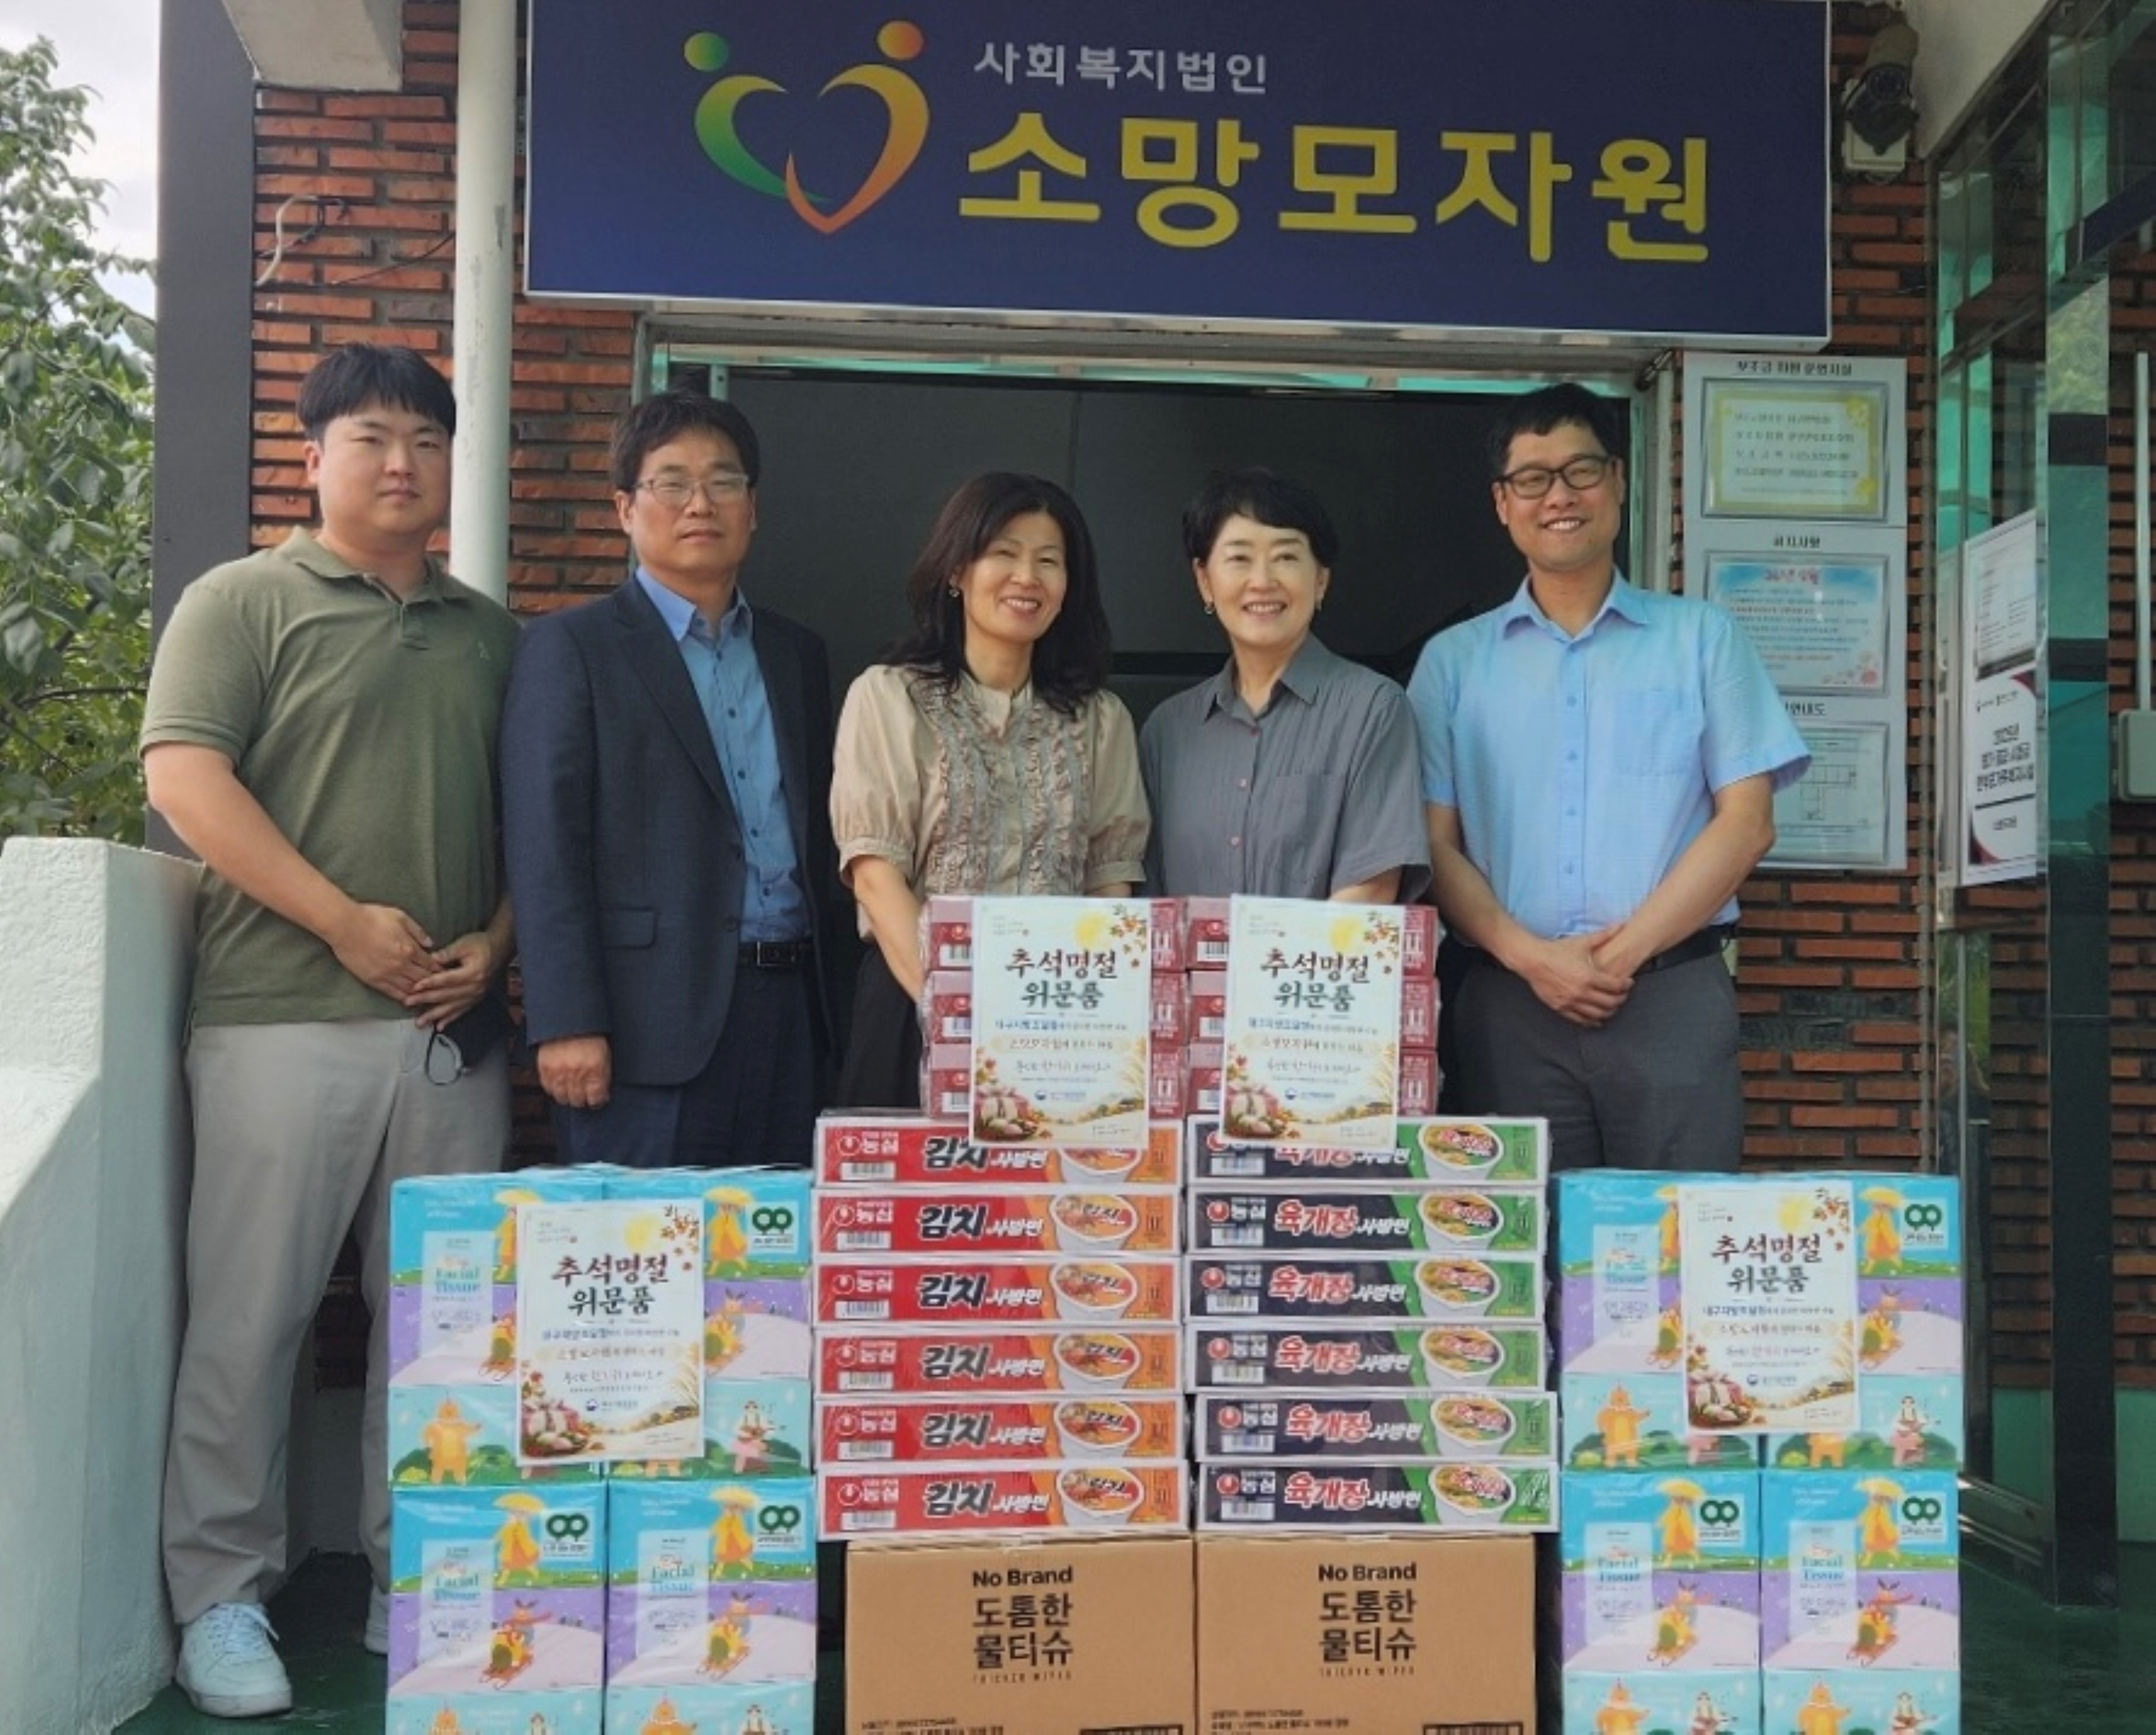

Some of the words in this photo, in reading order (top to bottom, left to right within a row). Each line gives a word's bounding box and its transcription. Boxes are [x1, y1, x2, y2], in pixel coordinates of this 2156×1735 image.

[975, 41, 1267, 96] 사회복지법인
[959, 111, 1708, 263] 소망모자원
[1007, 948, 1117, 979] 추석명절
[1261, 948, 1370, 984] 추석명절
[1021, 981, 1103, 1009] 위문품
[1274, 981, 1355, 1012] 위문품
[923, 1135, 988, 1171] 김치
[917, 1204, 987, 1242] 김치
[1273, 1199, 1359, 1238] 육개장
[1711, 1233, 1822, 1264] 추석명절
[551, 1254, 670, 1287] 추석명절
[1268, 1265, 1355, 1304] 육개장
[1727, 1265, 1810, 1294] 위문품
[567, 1286, 655, 1316] 위문품
[917, 1272, 987, 1310] 김치
[922, 1344, 990, 1381] 김치
[1274, 1335, 1360, 1374] 육개장
[922, 1412, 990, 1449] 김치
[1286, 1403, 1372, 1442] 육개장
[925, 1480, 994, 1518] 김치
[1284, 1471, 1370, 1510] 육개장
[973, 1570, 1001, 1587] No
[1007, 1566, 1073, 1587] Brand
[1319, 1564, 1348, 1581] No
[1353, 1562, 1417, 1581] Brand
[973, 1593, 1073, 1629] 도톰한
[1319, 1588, 1417, 1623] 도톰한
[973, 1631, 1074, 1669] 물티슈
[1319, 1628, 1417, 1663] 물티슈
